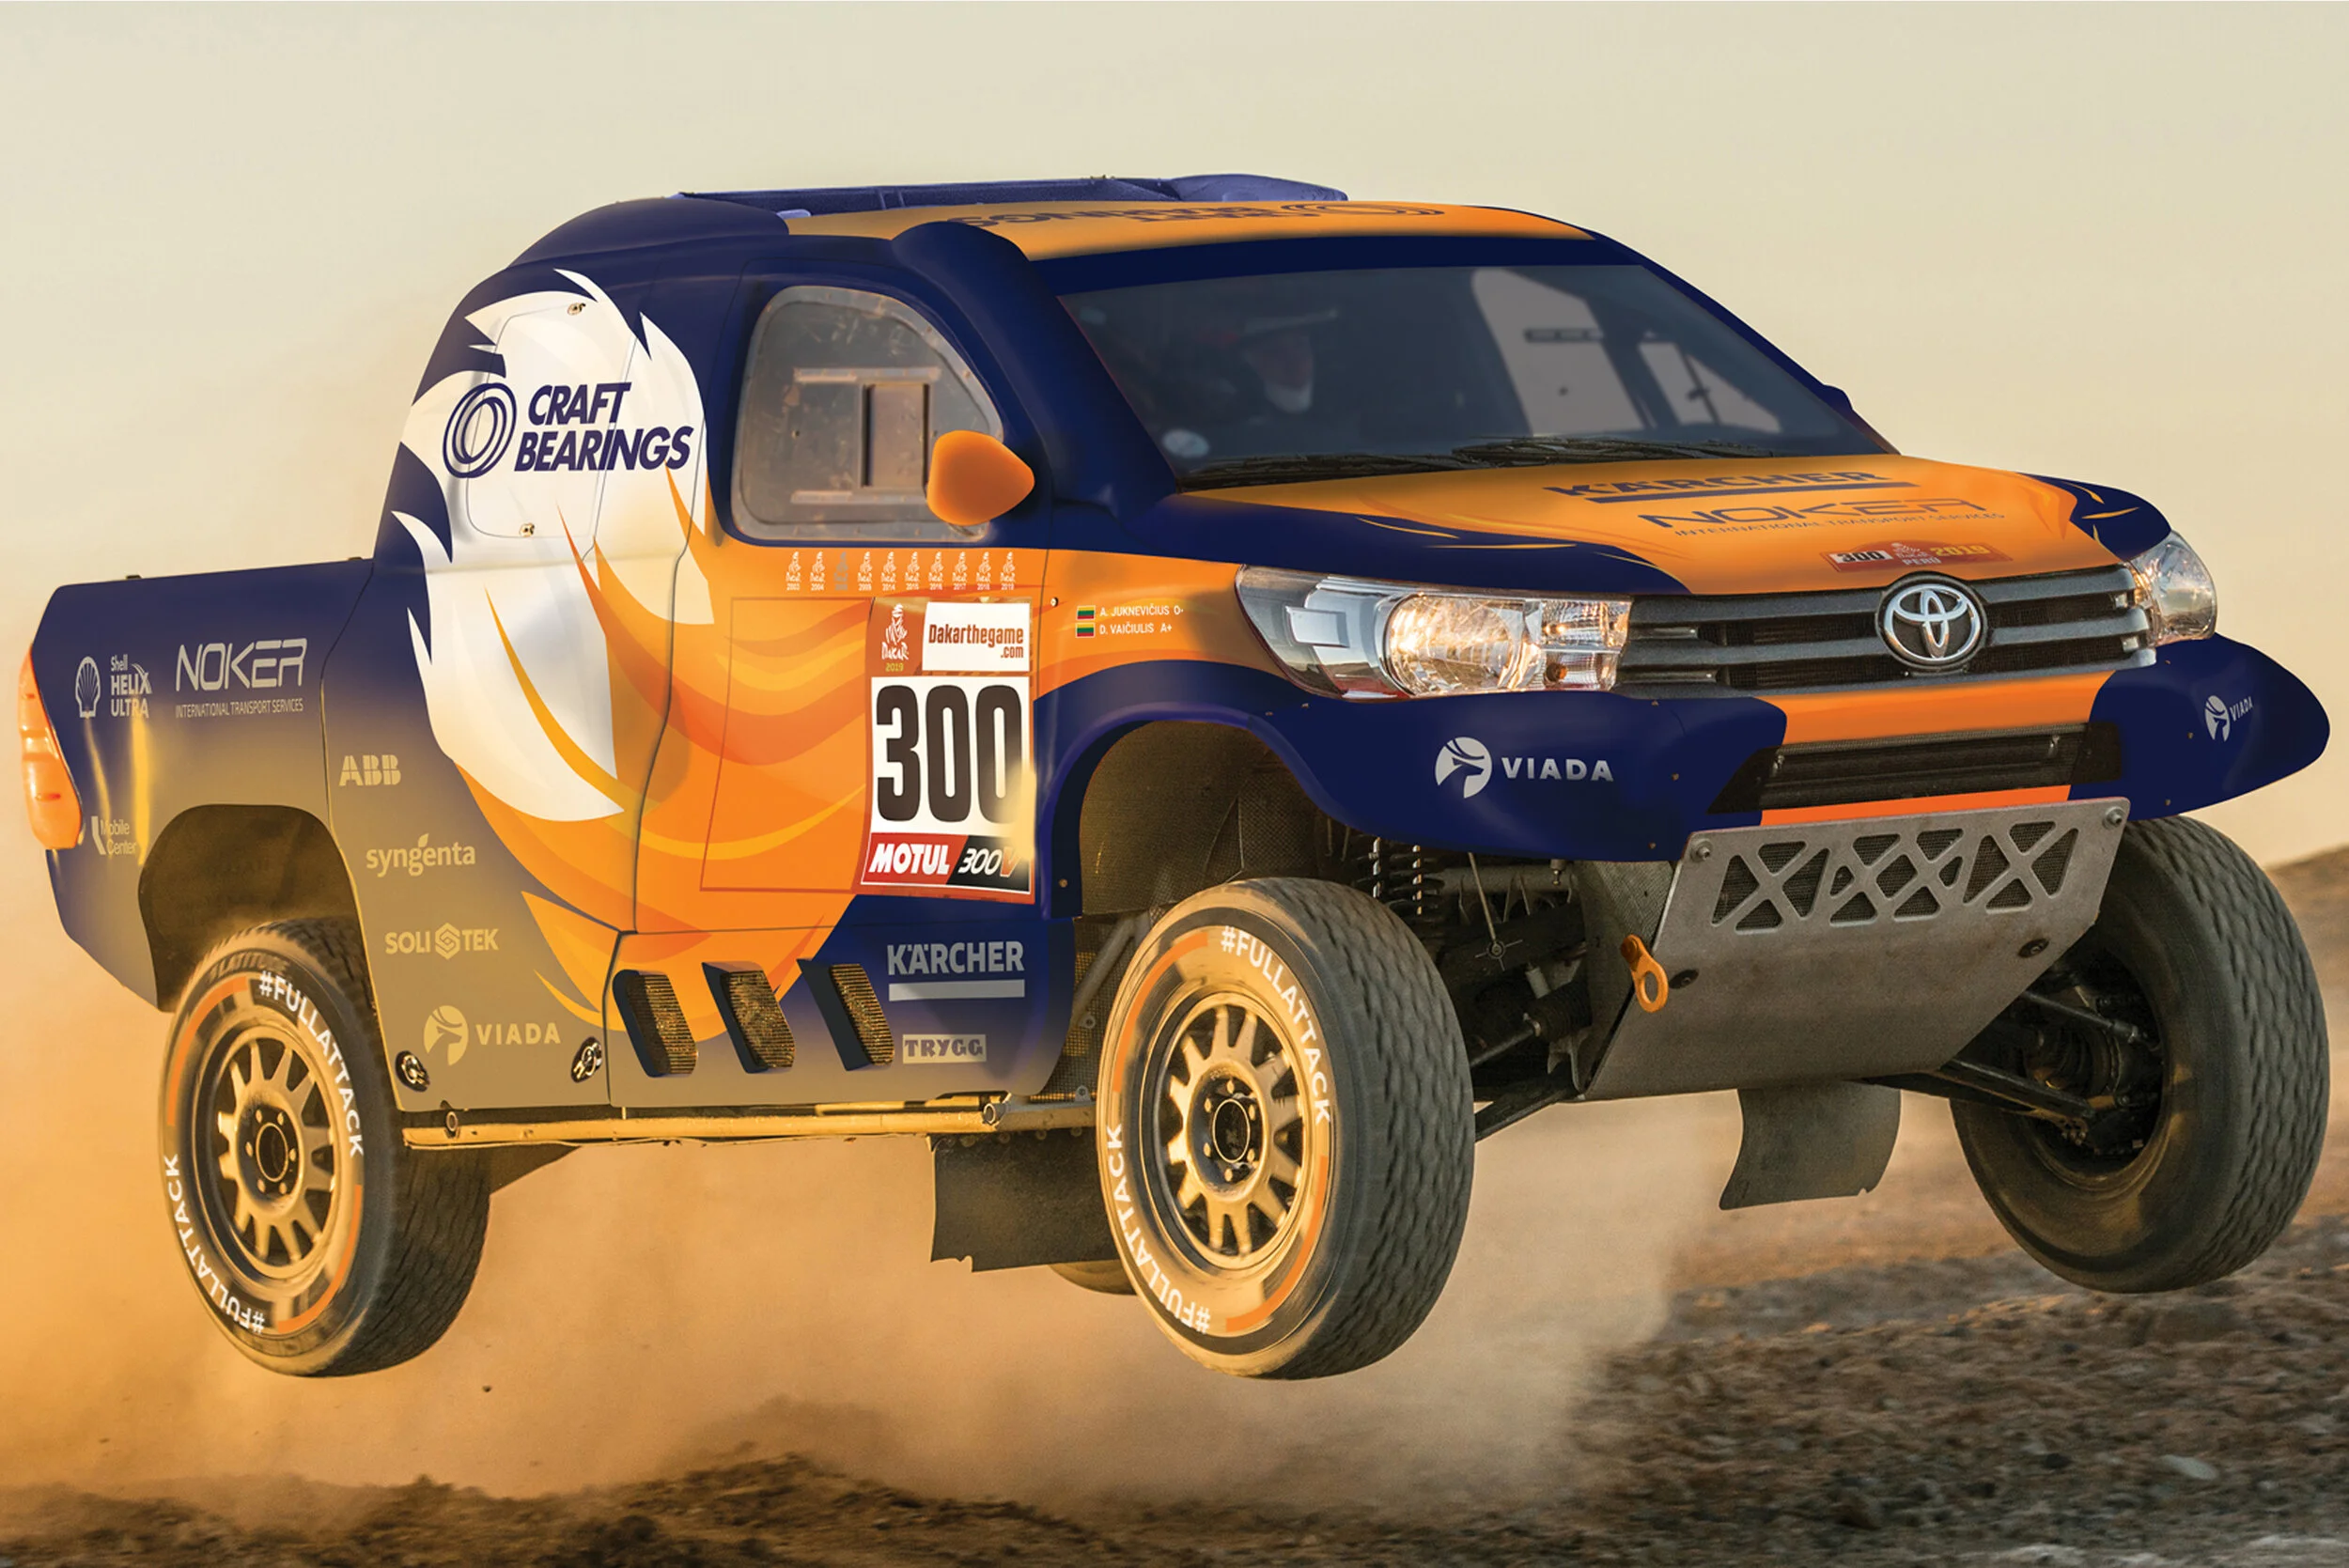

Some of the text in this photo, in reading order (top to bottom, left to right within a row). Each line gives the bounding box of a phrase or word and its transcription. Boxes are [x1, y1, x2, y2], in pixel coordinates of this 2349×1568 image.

[528, 381, 632, 426] CRAFT
[514, 426, 694, 472] BEARINGS
[1542, 472, 1891, 496] KÄRCHER
[1637, 497, 1987, 528] NOKER
[1837, 551, 1886, 563] 300
[1930, 545, 1991, 556] 2019
[1099, 607, 1108, 616] A.
[1111, 602, 1170, 616] JUKNEVIČIUS
[928, 624, 1024, 647] Dakarthegame
[1099, 621, 1172, 634] D. VAIČIULIS A+
[110, 654, 129, 672] Shell
[176, 638, 308, 691] NOKER
[1001, 645, 1024, 659] .com
[885, 662, 904, 673] 2019
[110, 671, 152, 696] HELIX
[110, 698, 149, 718] ULTRA
[175, 698, 303, 719] INTERNATIONAL TRANSPORT SERVICES
[2229, 696, 2253, 722] VIADA
[876, 685, 1022, 824] 300
[338, 754, 401, 786] ABB
[1501, 757, 1614, 782] VIADA
[100, 818, 130, 835] Mobile
[106, 838, 137, 855] Center
[366, 842, 476, 877] syngenta
[868, 843, 1021, 877] MOTUL 300V
[887, 940, 1025, 975] KÄRCHER
[475, 1022, 561, 1045] VIADA
[1221, 925, 1330, 1125] #FULLATTACK
[904, 1038, 984, 1058] TRYGG
[258, 970, 365, 1157] #FULLATTACK
[1106, 1123, 1211, 1334] #FULLATTACK
[163, 1154, 265, 1334] #FULLATTACK
